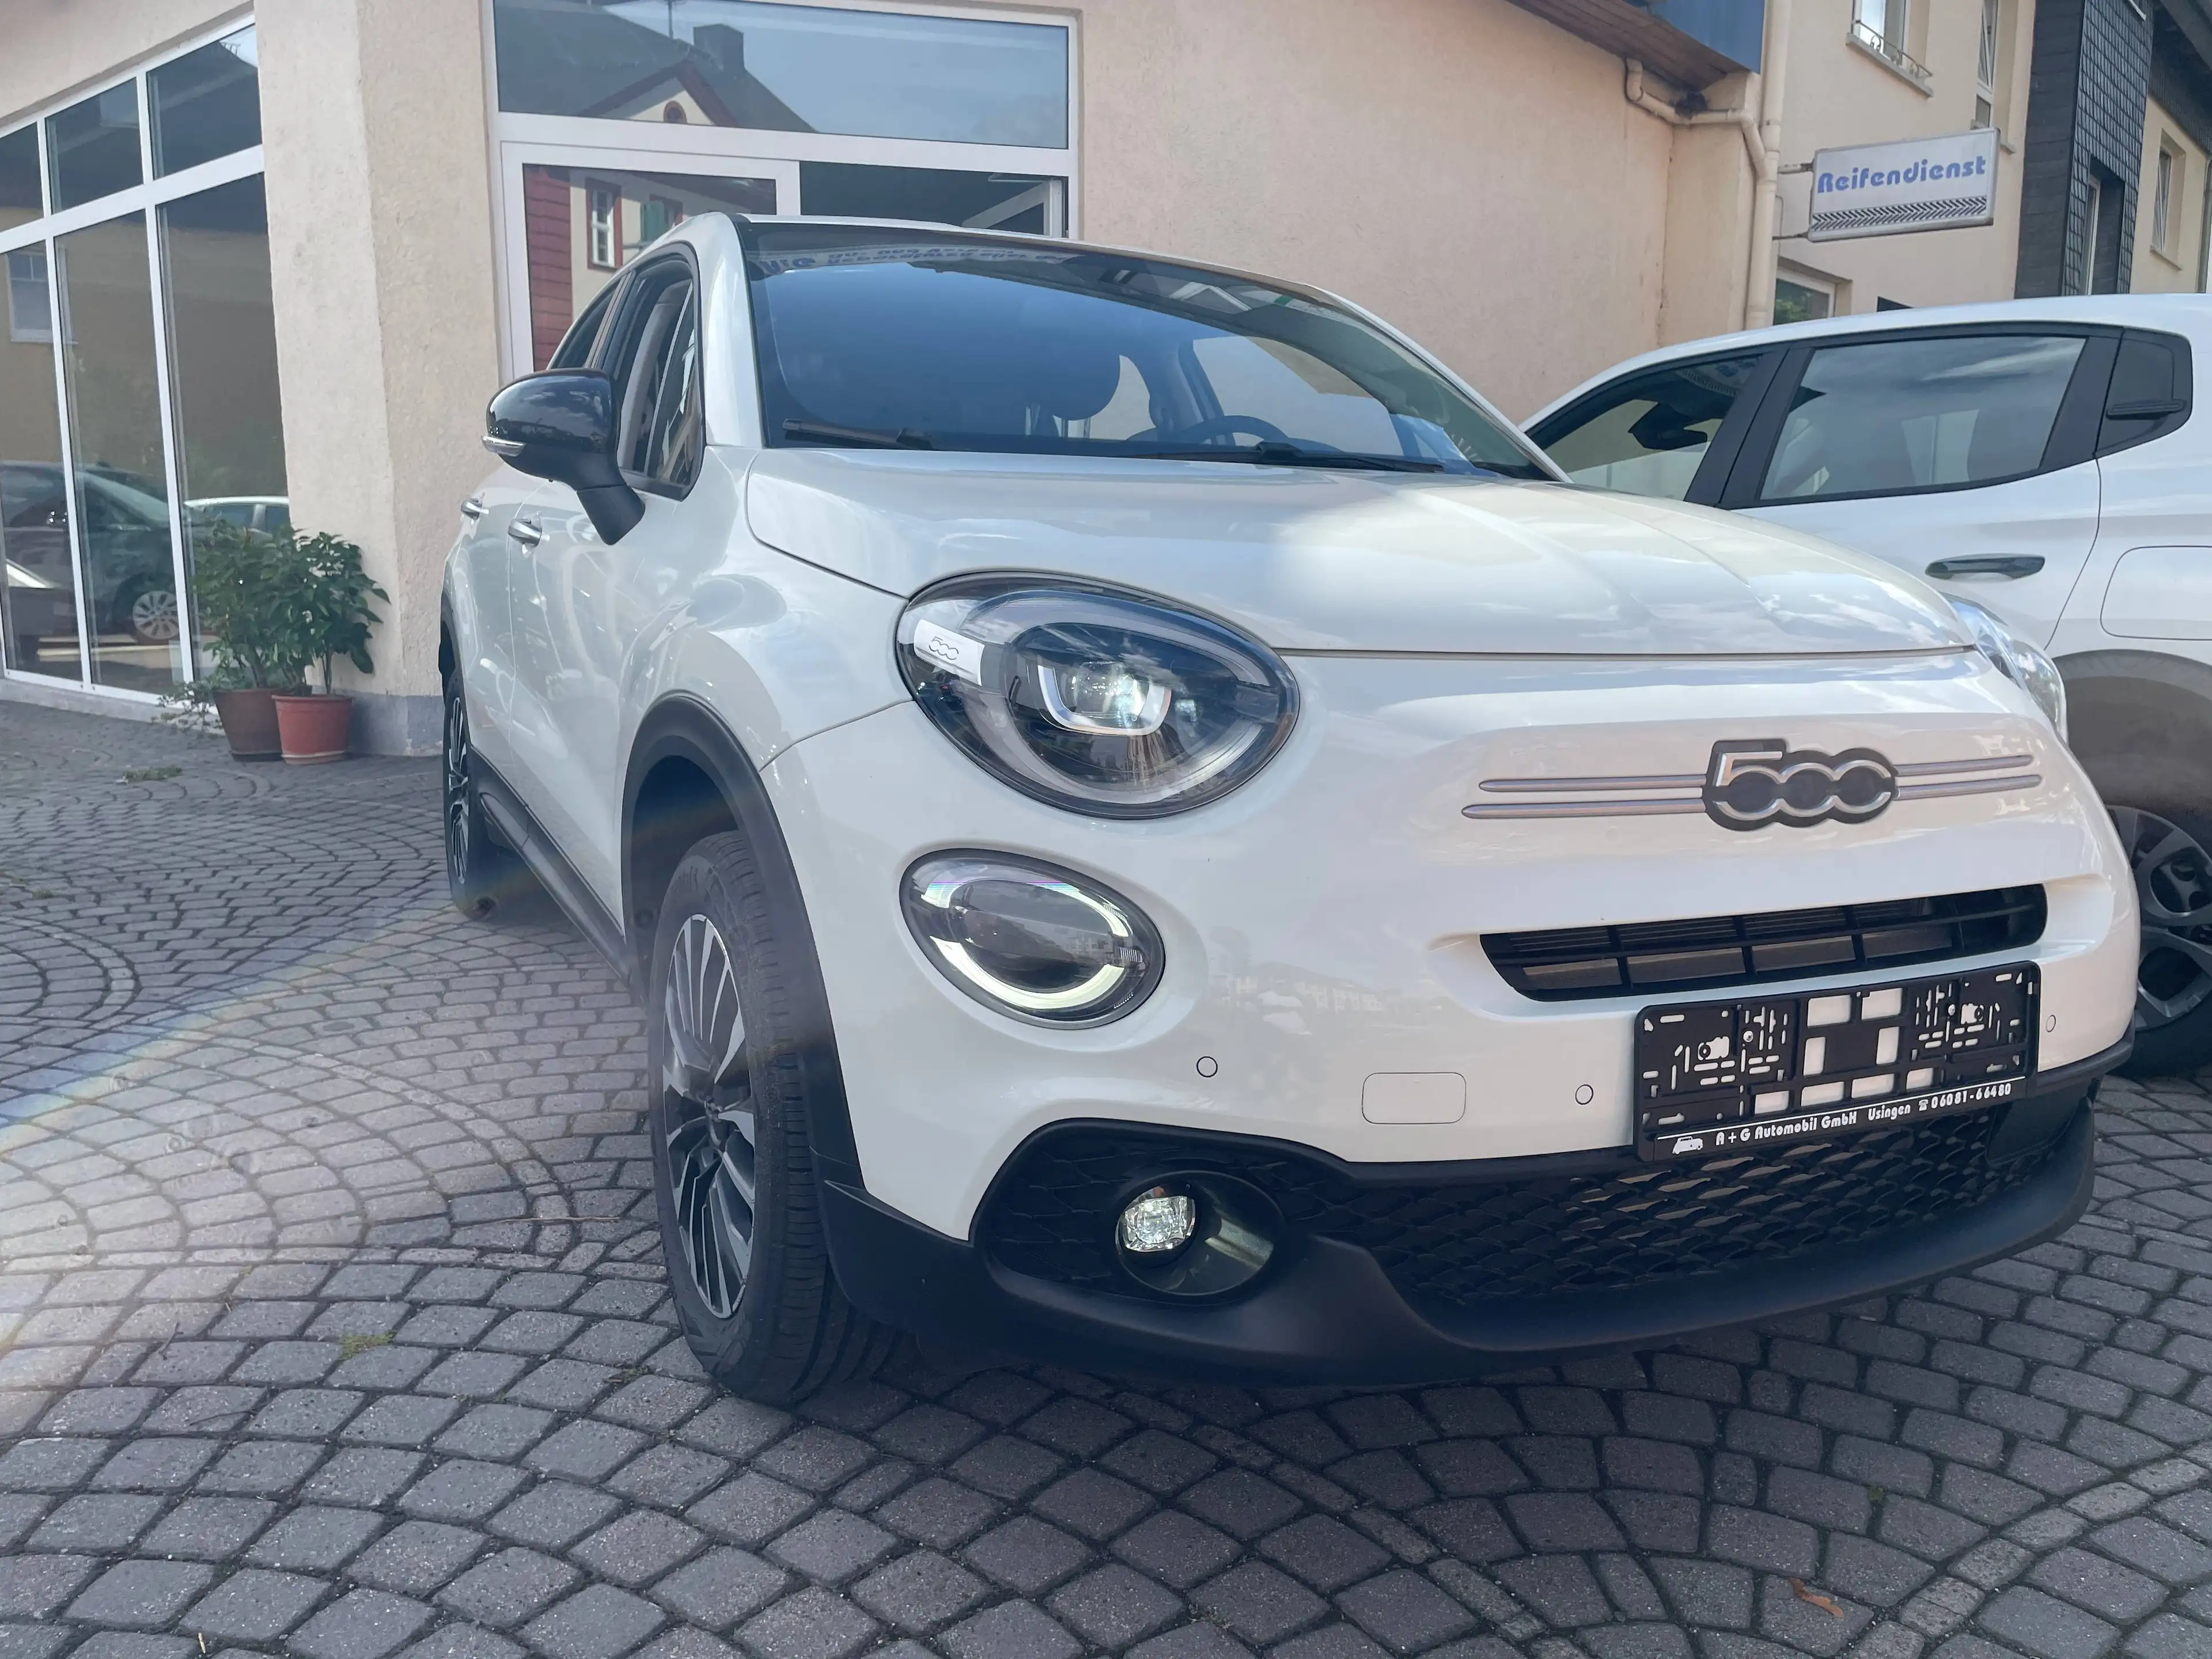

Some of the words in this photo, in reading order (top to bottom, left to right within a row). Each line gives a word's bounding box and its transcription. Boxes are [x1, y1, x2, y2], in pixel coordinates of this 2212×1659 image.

[1817, 156, 1986, 194] Reifendienst
[929, 636, 959, 660] 500
[1707, 743, 1894, 827] 500
[1715, 1132, 1725, 1146] A
[1740, 1128, 1751, 1142] G
[1755, 1117, 1817, 1139] Automobil
[1821, 1111, 1857, 1129] GmbH
[1868, 1105, 1911, 1120] Usingen
[1931, 1083, 2012, 1109] 06081-66480
